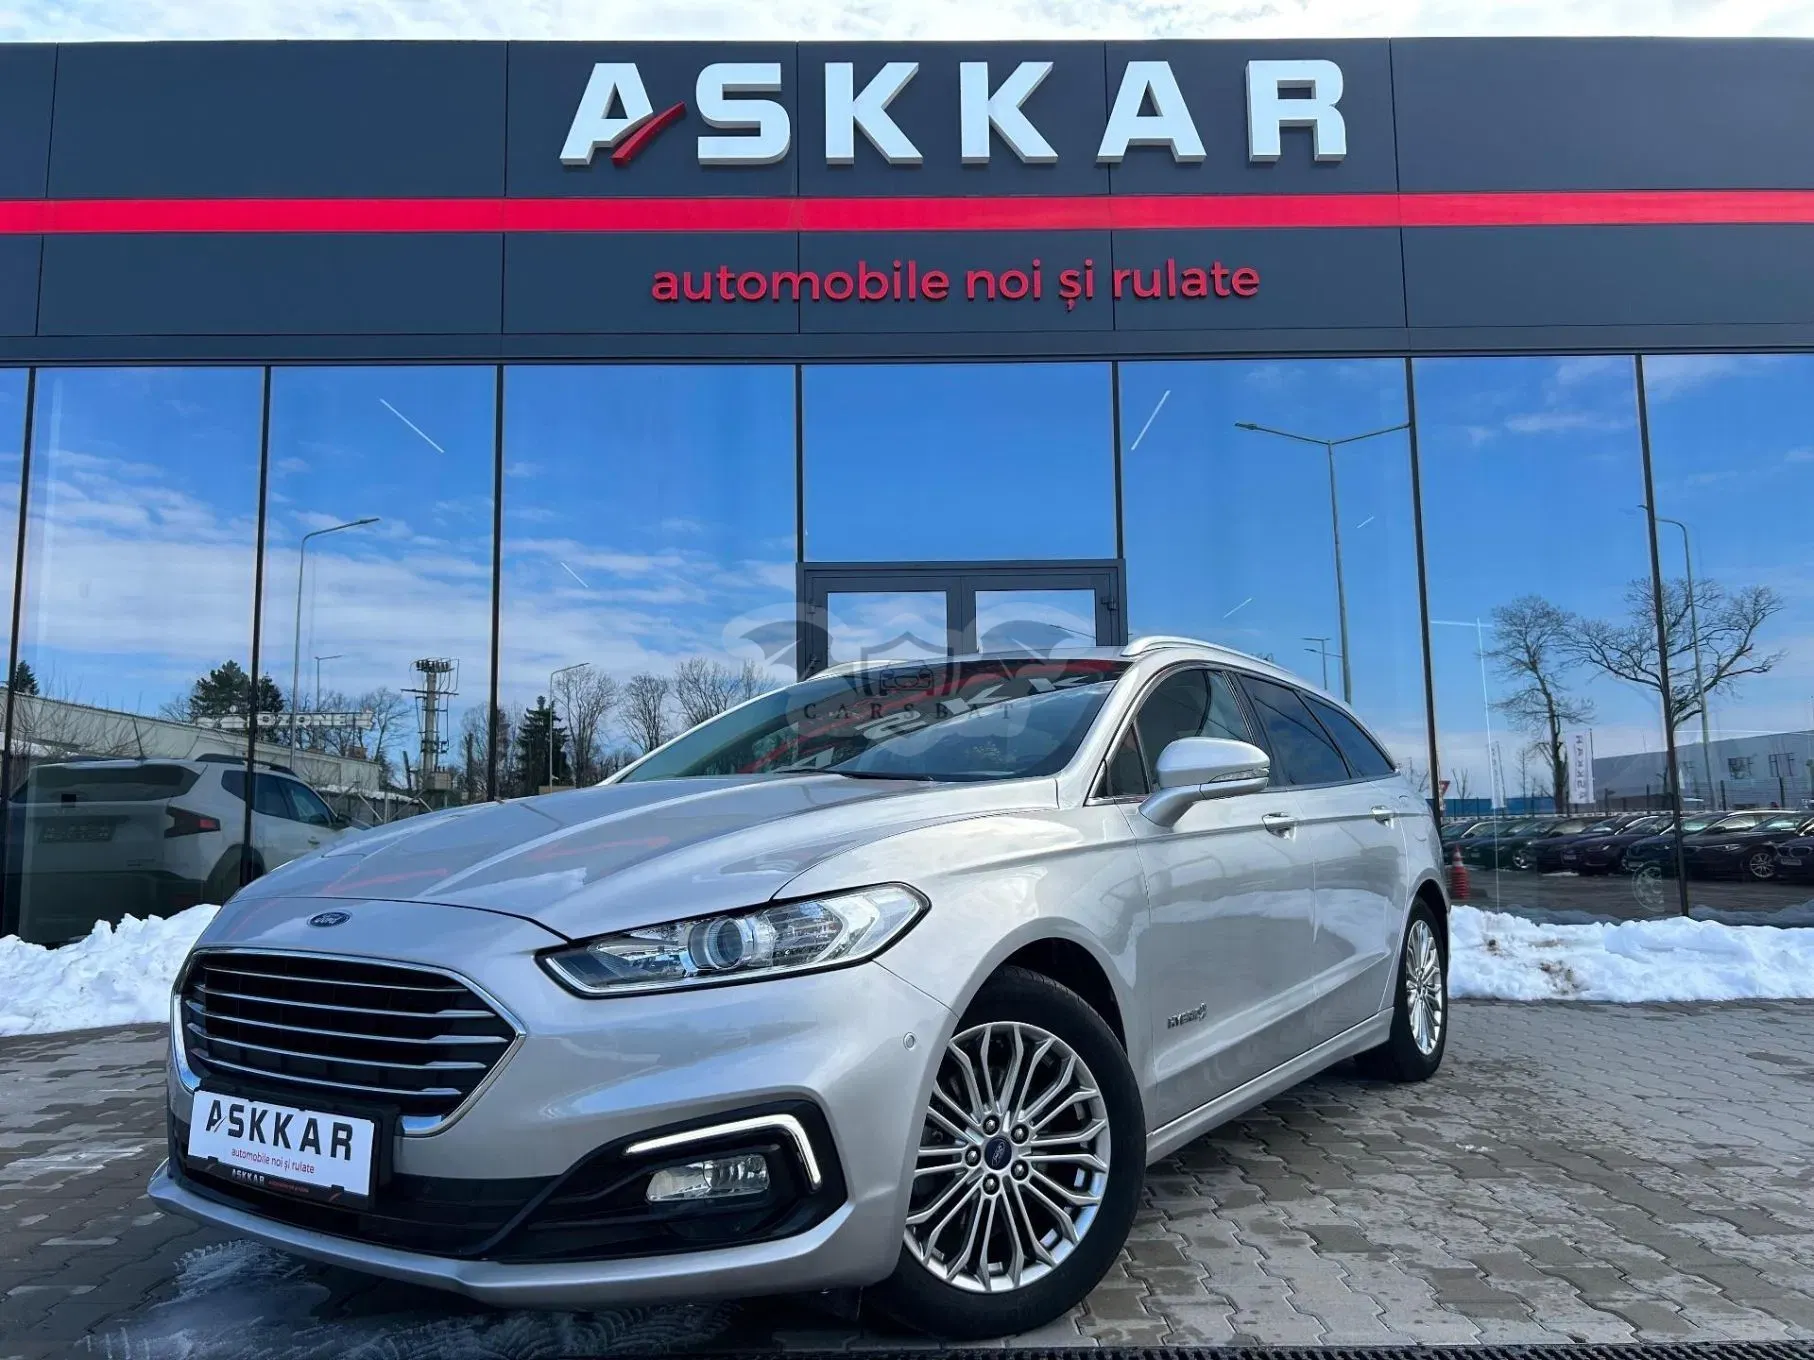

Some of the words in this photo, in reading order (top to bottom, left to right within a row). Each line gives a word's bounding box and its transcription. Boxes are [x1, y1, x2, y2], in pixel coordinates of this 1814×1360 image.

[559, 59, 1348, 167] ASKKAR
[652, 260, 950, 304] automobile
[966, 258, 1042, 301] noi
[1059, 257, 1095, 312] și
[1113, 257, 1261, 301] rulate
[205, 1099, 354, 1161] ASKKAR
[231, 1148, 270, 1165] automobile
[271, 1156, 284, 1167] noi
[292, 1161, 315, 1174] rulate
[231, 1168, 265, 1185] ASKKAR
